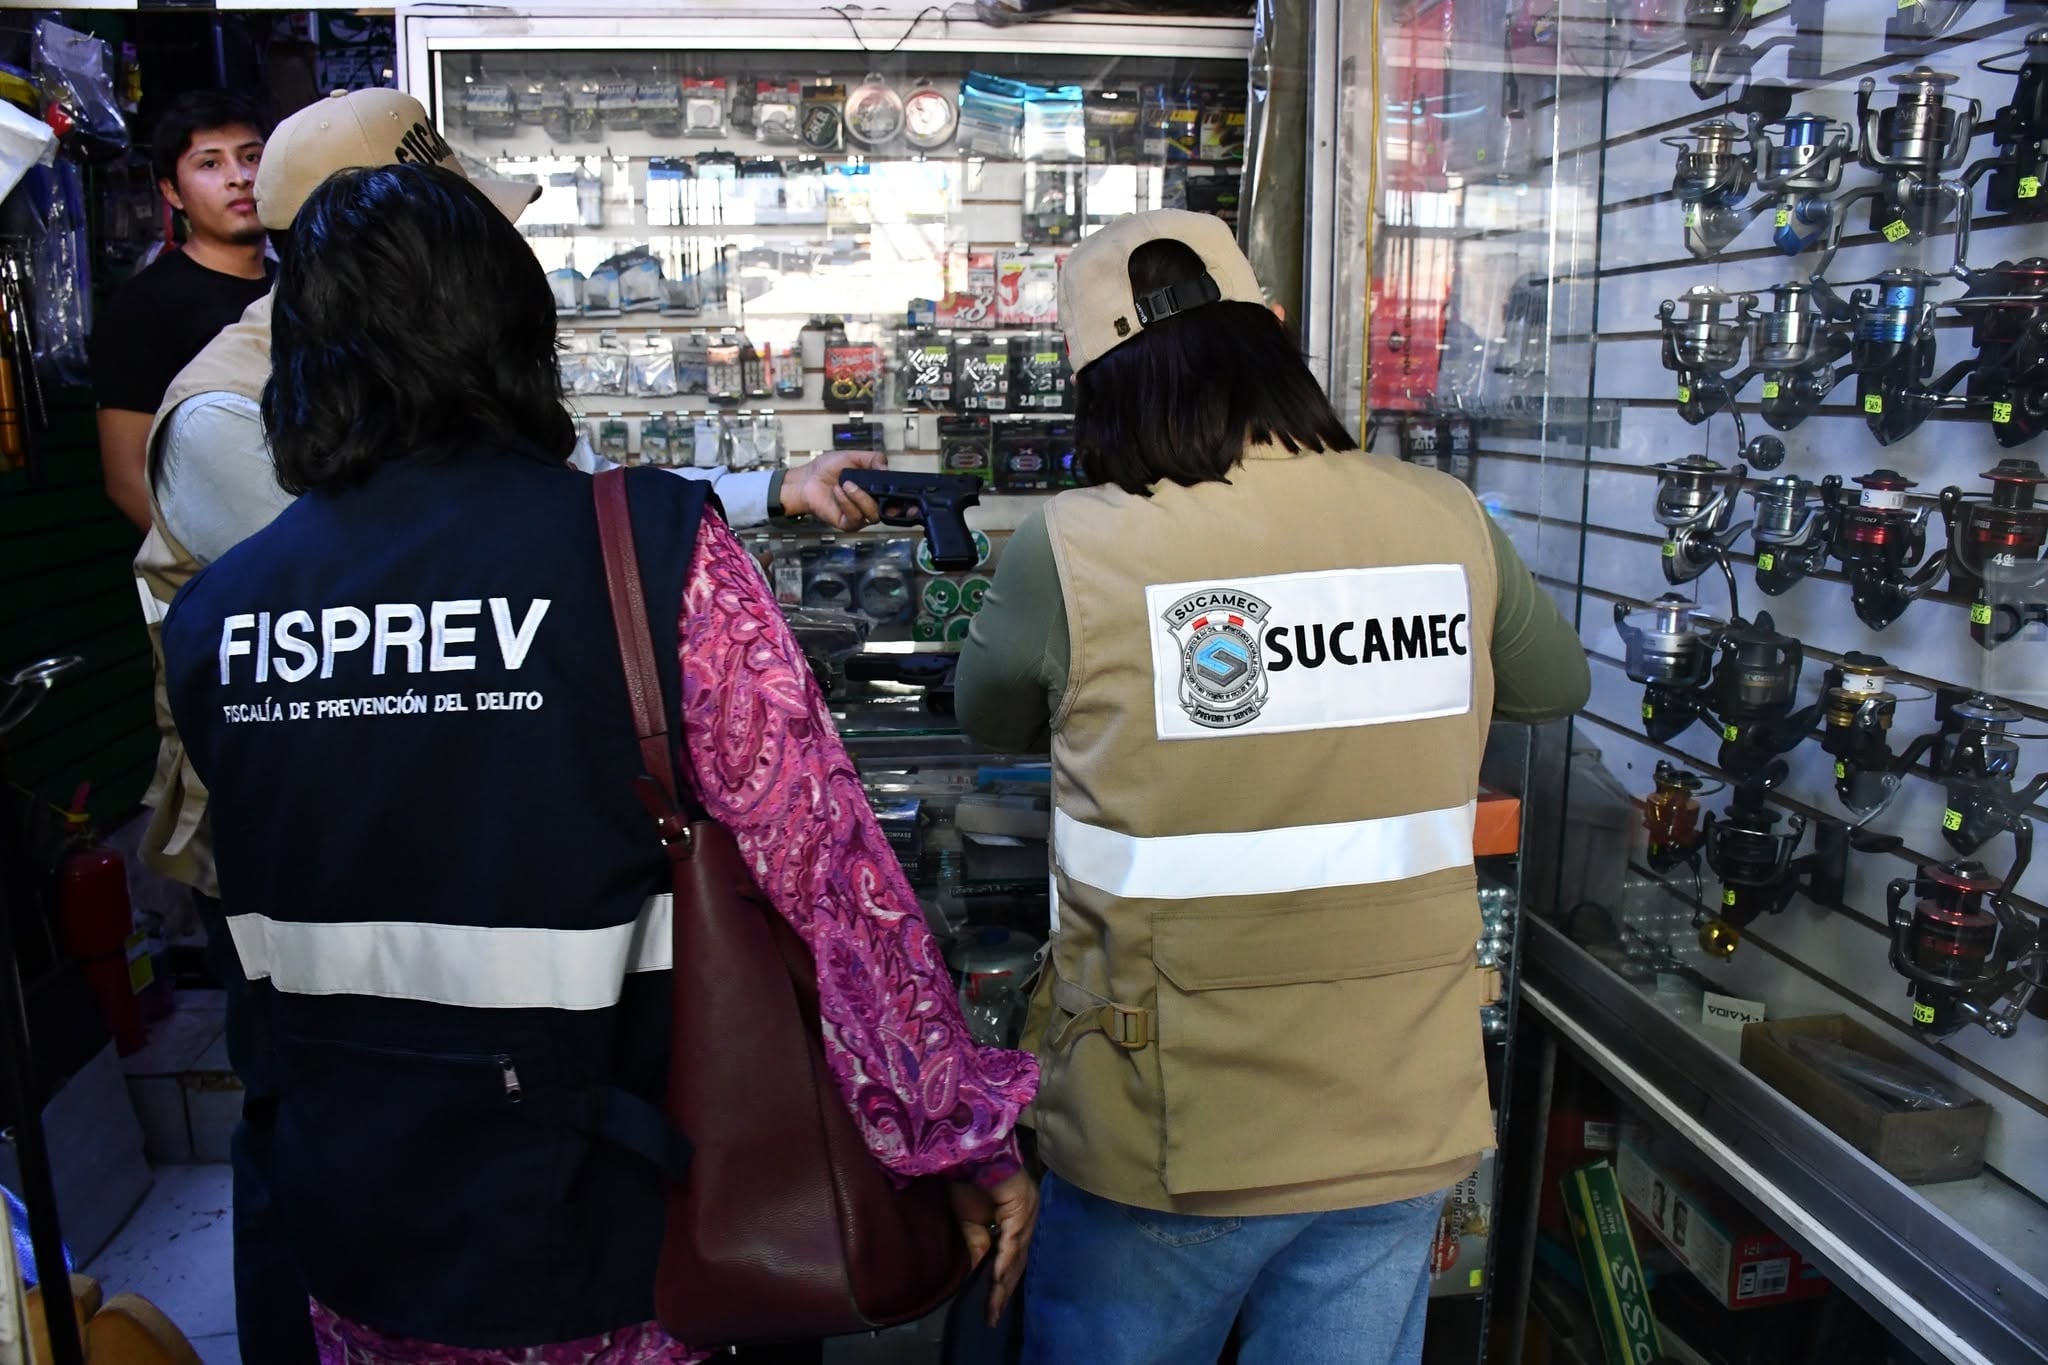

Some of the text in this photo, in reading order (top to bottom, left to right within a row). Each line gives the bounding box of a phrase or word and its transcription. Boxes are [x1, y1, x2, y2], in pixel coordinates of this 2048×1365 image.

[1174, 593, 1260, 621] SUCAMEC
[219, 598, 551, 685] FISPREV
[1265, 613, 1467, 671] SUCAMEC
[223, 689, 544, 723] FISCALÍA DE PREVENCIÓN DEL DELITO
[1708, 1005, 1750, 1022] KAIDA
